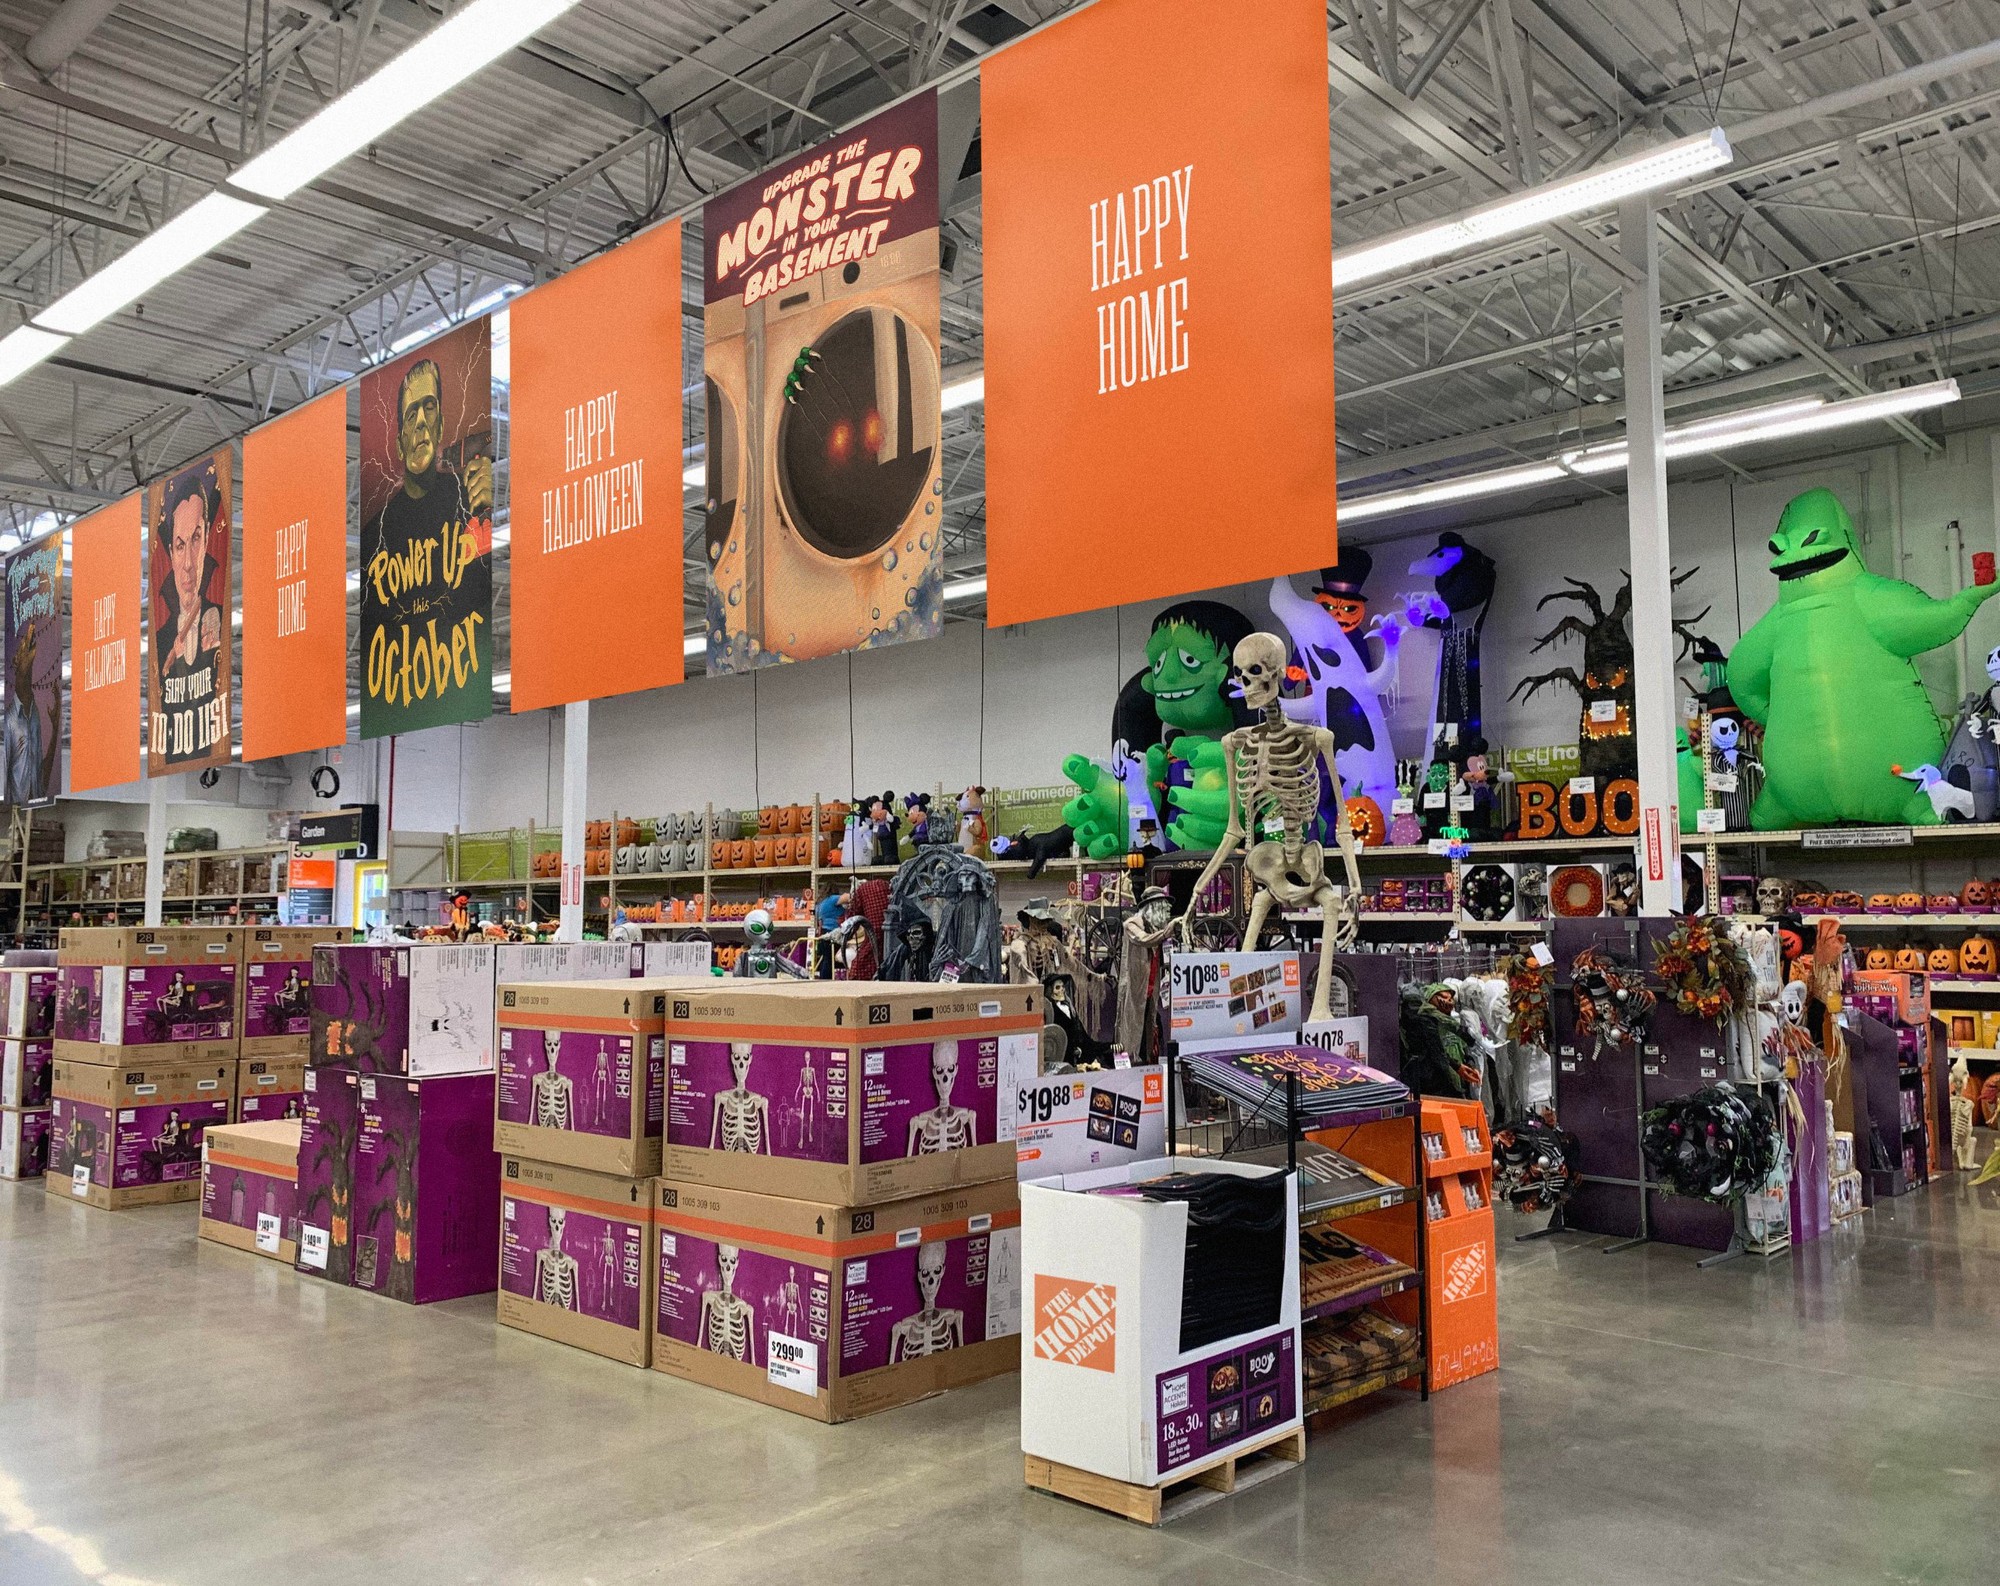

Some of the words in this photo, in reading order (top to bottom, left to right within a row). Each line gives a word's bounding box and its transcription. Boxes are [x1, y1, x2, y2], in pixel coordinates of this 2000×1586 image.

[763, 155, 831, 203] UPGRADE
[836, 138, 868, 164] THE
[717, 146, 922, 280] MONSTER
[1090, 164, 1194, 292] HAPPY
[782, 232, 797, 254] IN
[803, 214, 840, 242] YOUR
[743, 219, 889, 306] BASEMENT
[1097, 276, 1189, 395] HOME
[565, 390, 618, 473] HAPPY
[543, 459, 643, 554] HALLOWEEN
[276, 519, 308, 580] HAPPY
[94, 592, 116, 641] HAPPY
[277, 580, 306, 638] HOME
[413, 598, 430, 614] this
[84, 638, 126, 691] HALLOWEEN
[367, 610, 484, 708] October
[164, 676, 187, 704] SLAY
[188, 666, 212, 698] YOUR
[198, 692, 229, 750] LIST
[1517, 779, 1640, 838] BOO
[302, 826, 325, 838] Garden
[1440, 826, 1469, 839] TRICK
[138, 933, 153, 943] 28
[257, 931, 270, 941] 28
[504, 993, 514, 1005] 28
[657, 998, 665, 1011] 2
[675, 1002, 687, 1016] 28
[694, 1007, 708, 1015] 1005
[710, 1007, 721, 1016] 309
[724, 1008, 735, 1016] 103
[872, 1006, 888, 1022] 28
[952, 1004, 964, 1012] 309
[967, 1003, 977, 1011] 103
[128, 1074, 142, 1084] 28
[251, 1064, 265, 1073] 28
[1146, 1090, 1160, 1098] VALUE
[507, 1163, 518, 1176] 28
[664, 1190, 676, 1206] 28
[682, 1196, 695, 1207] 1005
[697, 1200, 708, 1209] 309
[709, 1201, 720, 1211] 103
[855, 1214, 872, 1231] 28
[923, 1206, 939, 1215] 1005
[941, 1202, 953, 1212] 309
[956, 1200, 968, 1209] 103
[1443, 1244, 1485, 1301] HOME
[1447, 1254, 1464, 1277] THE
[1460, 1261, 1486, 1297] DEPOT
[1042, 1287, 1075, 1319] THE
[1035, 1283, 1116, 1360] HOME
[1065, 1317, 1115, 1365] DEPOT
[1250, 1355, 1267, 1372] BOO
[1164, 1391, 1187, 1403] ACCENTS
[1172, 1383, 1186, 1393] HOME
[1170, 1400, 1186, 1409] Holiday
